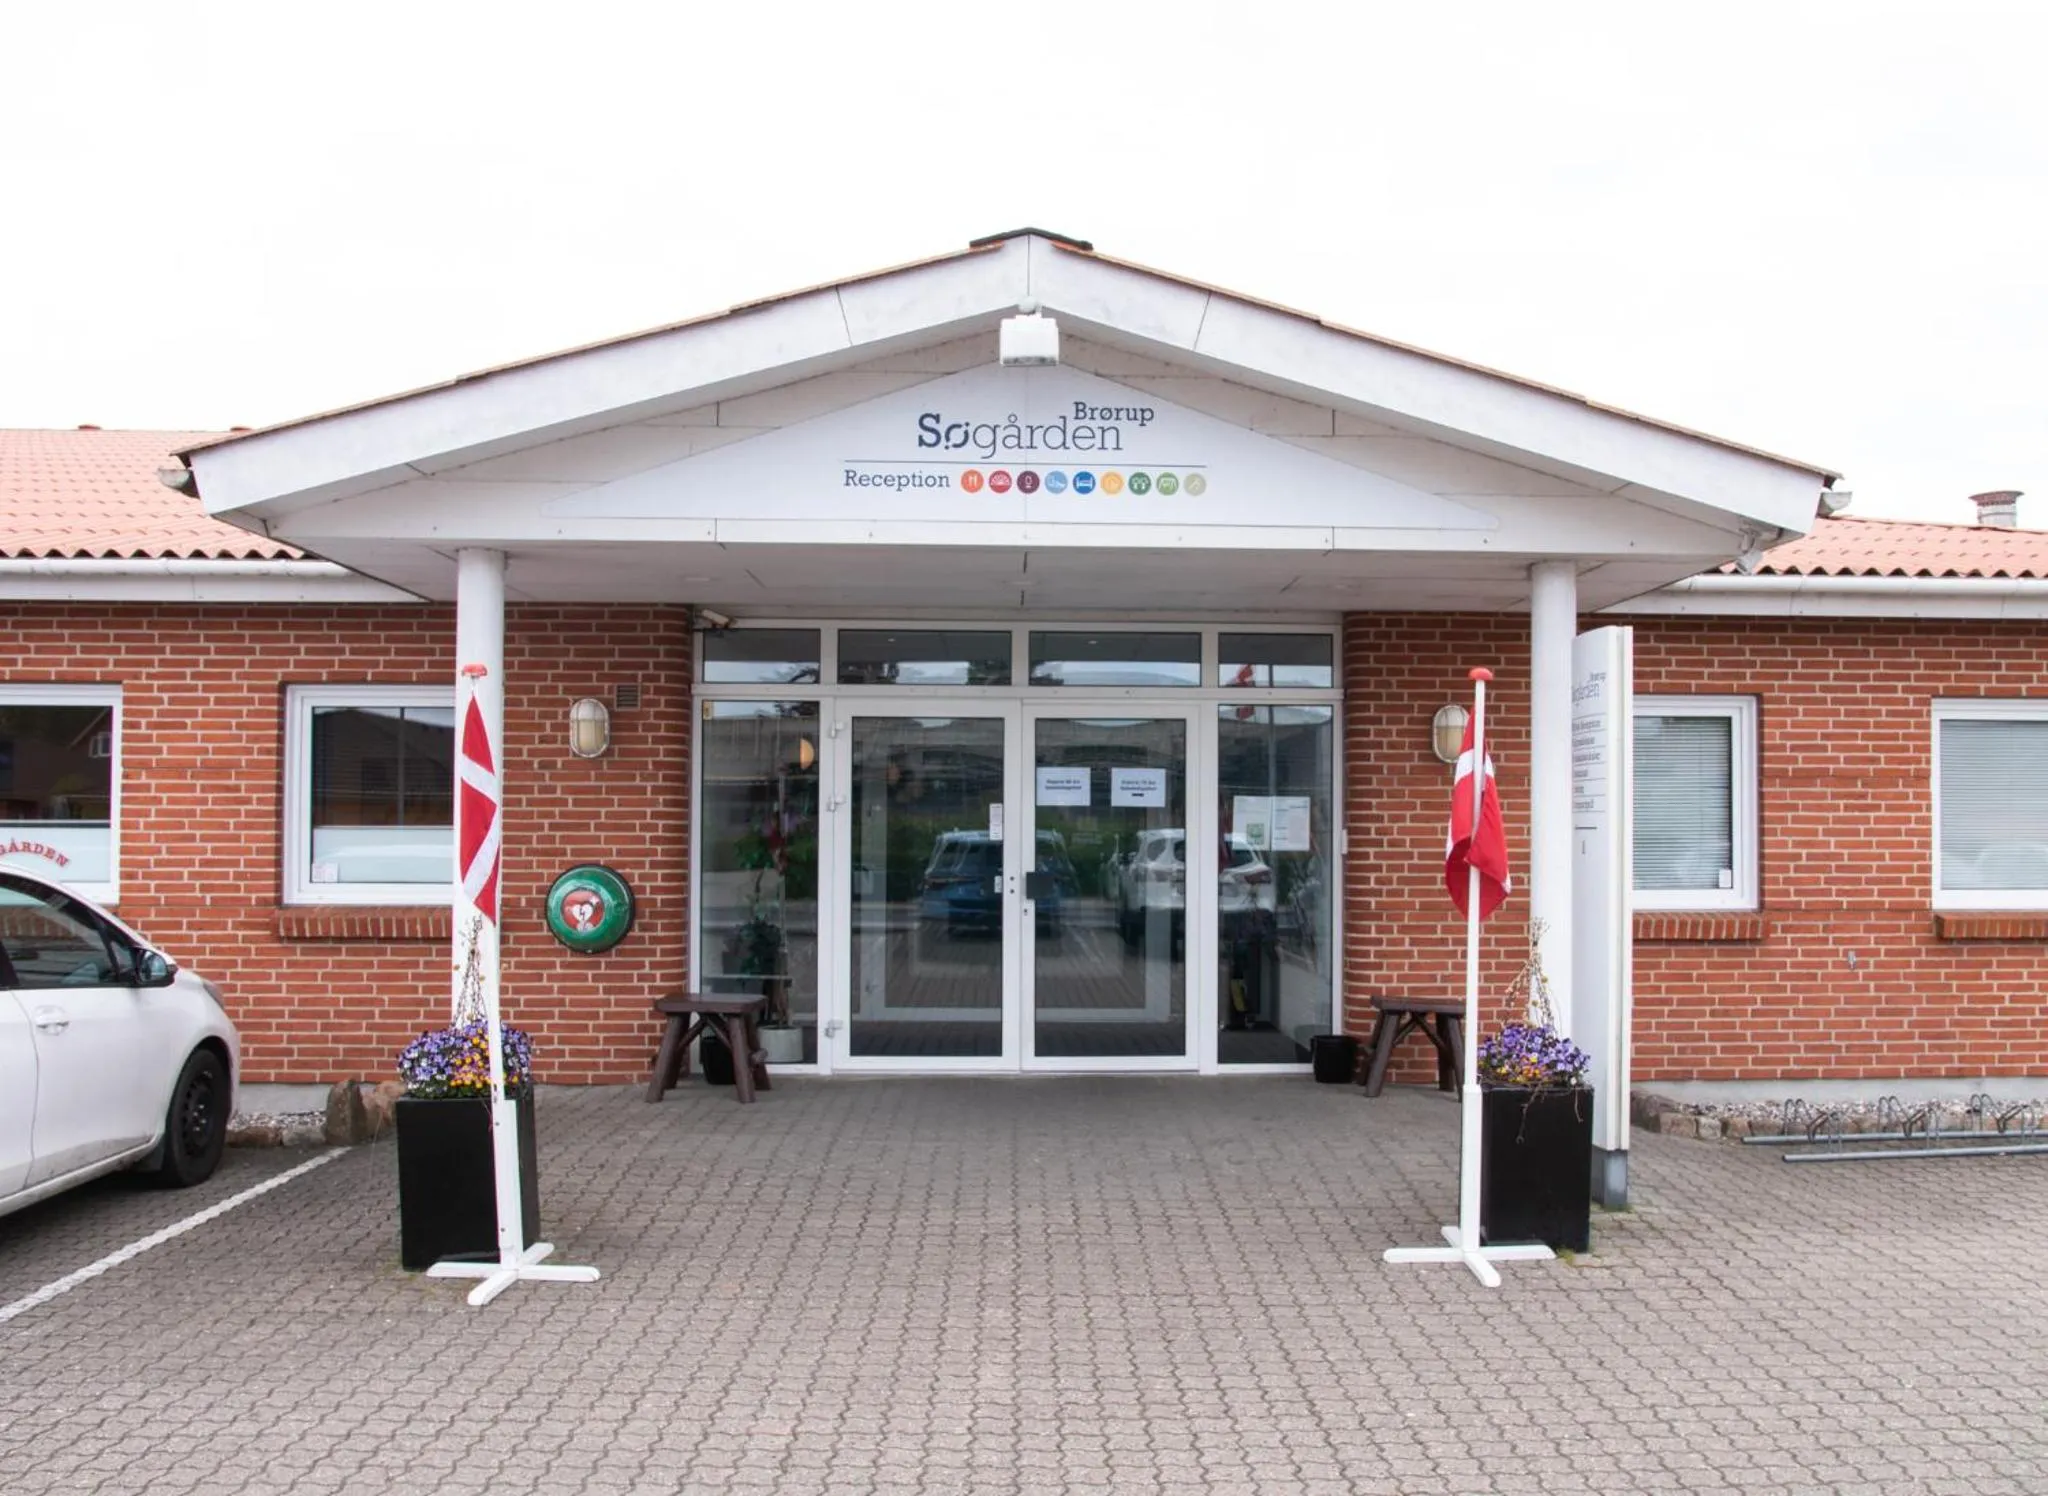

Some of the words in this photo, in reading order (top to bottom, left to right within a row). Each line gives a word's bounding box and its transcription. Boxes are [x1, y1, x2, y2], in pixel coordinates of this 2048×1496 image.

[1073, 401, 1154, 426] Brørup
[918, 412, 1123, 459] Søgården
[844, 469, 950, 491] Reception
